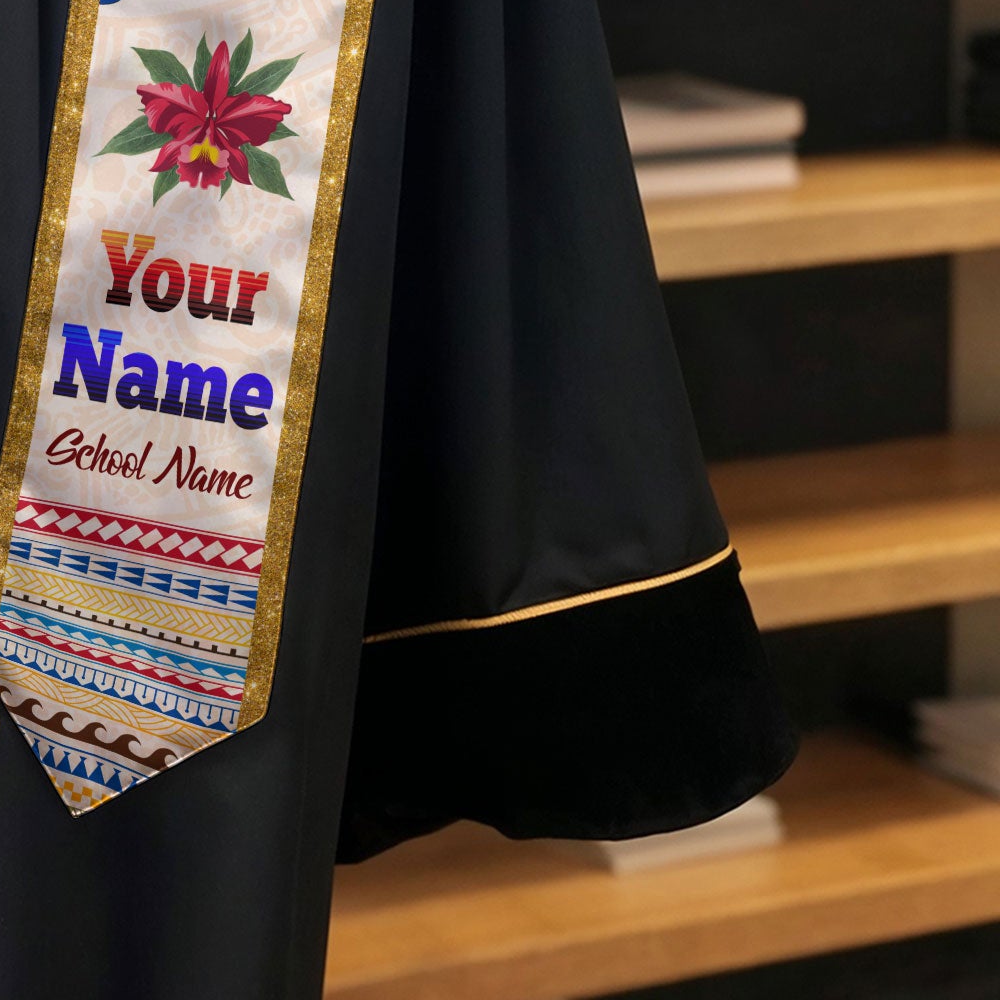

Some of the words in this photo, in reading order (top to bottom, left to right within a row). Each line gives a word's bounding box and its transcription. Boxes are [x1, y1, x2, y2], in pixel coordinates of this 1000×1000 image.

[100, 229, 270, 326] Your
[52, 322, 274, 431] Name
[45, 428, 153, 480] School
[152, 445, 254, 500] Name
